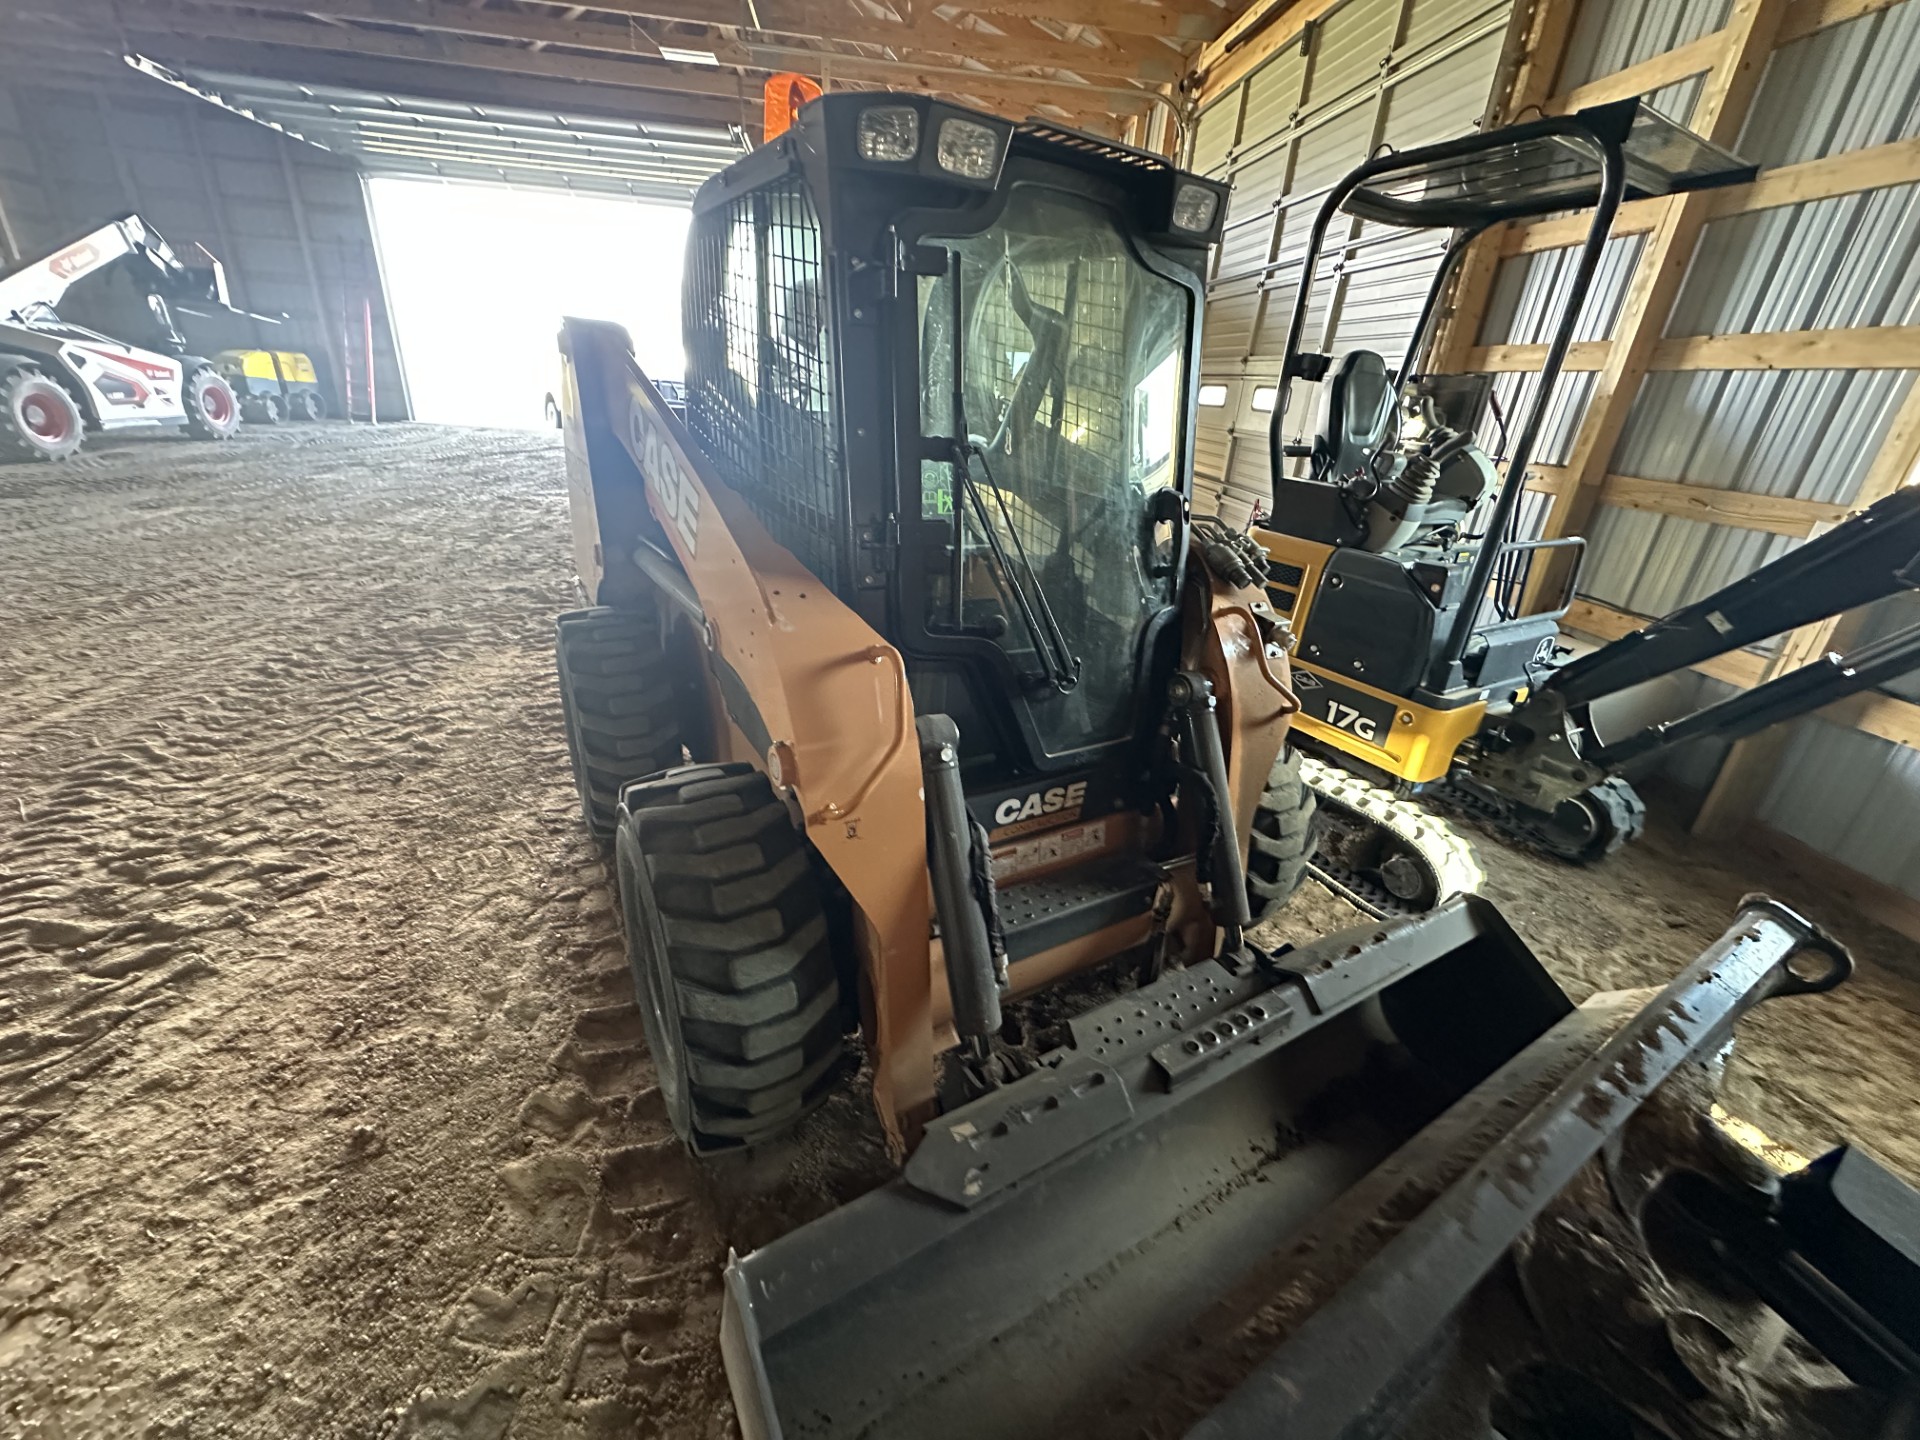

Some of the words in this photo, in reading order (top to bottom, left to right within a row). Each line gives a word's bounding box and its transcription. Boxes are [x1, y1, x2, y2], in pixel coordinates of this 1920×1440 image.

[629, 394, 699, 560] CASE
[1326, 700, 1377, 741] 17G
[995, 781, 1088, 825] CASE
